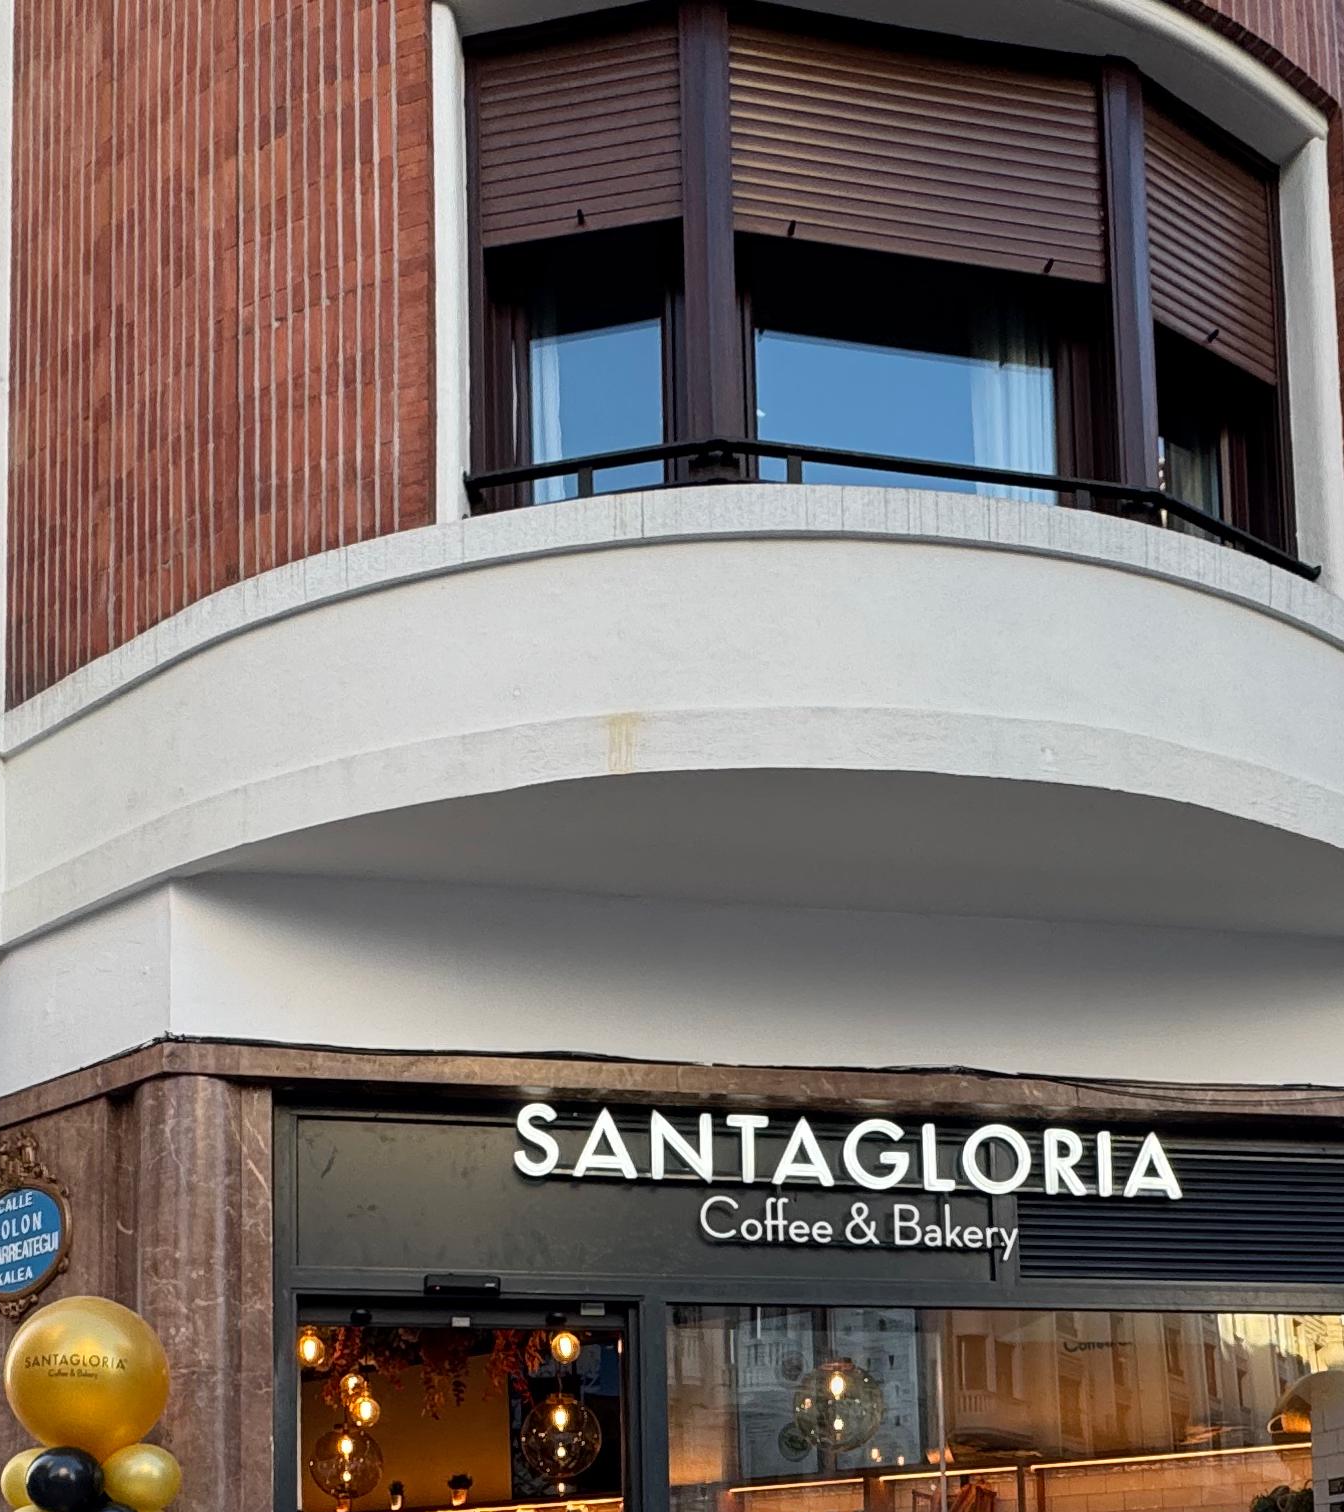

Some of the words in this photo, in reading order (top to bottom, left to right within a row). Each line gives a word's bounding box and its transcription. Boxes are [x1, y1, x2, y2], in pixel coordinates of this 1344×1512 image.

[514, 1102, 1184, 1200] SANTAGLORIA
[700, 1196, 833, 1243] Coffee
[845, 1202, 880, 1245] &
[893, 1203, 1019, 1261] Bakery
[24, 1354, 126, 1370] SANTAGLORIA
